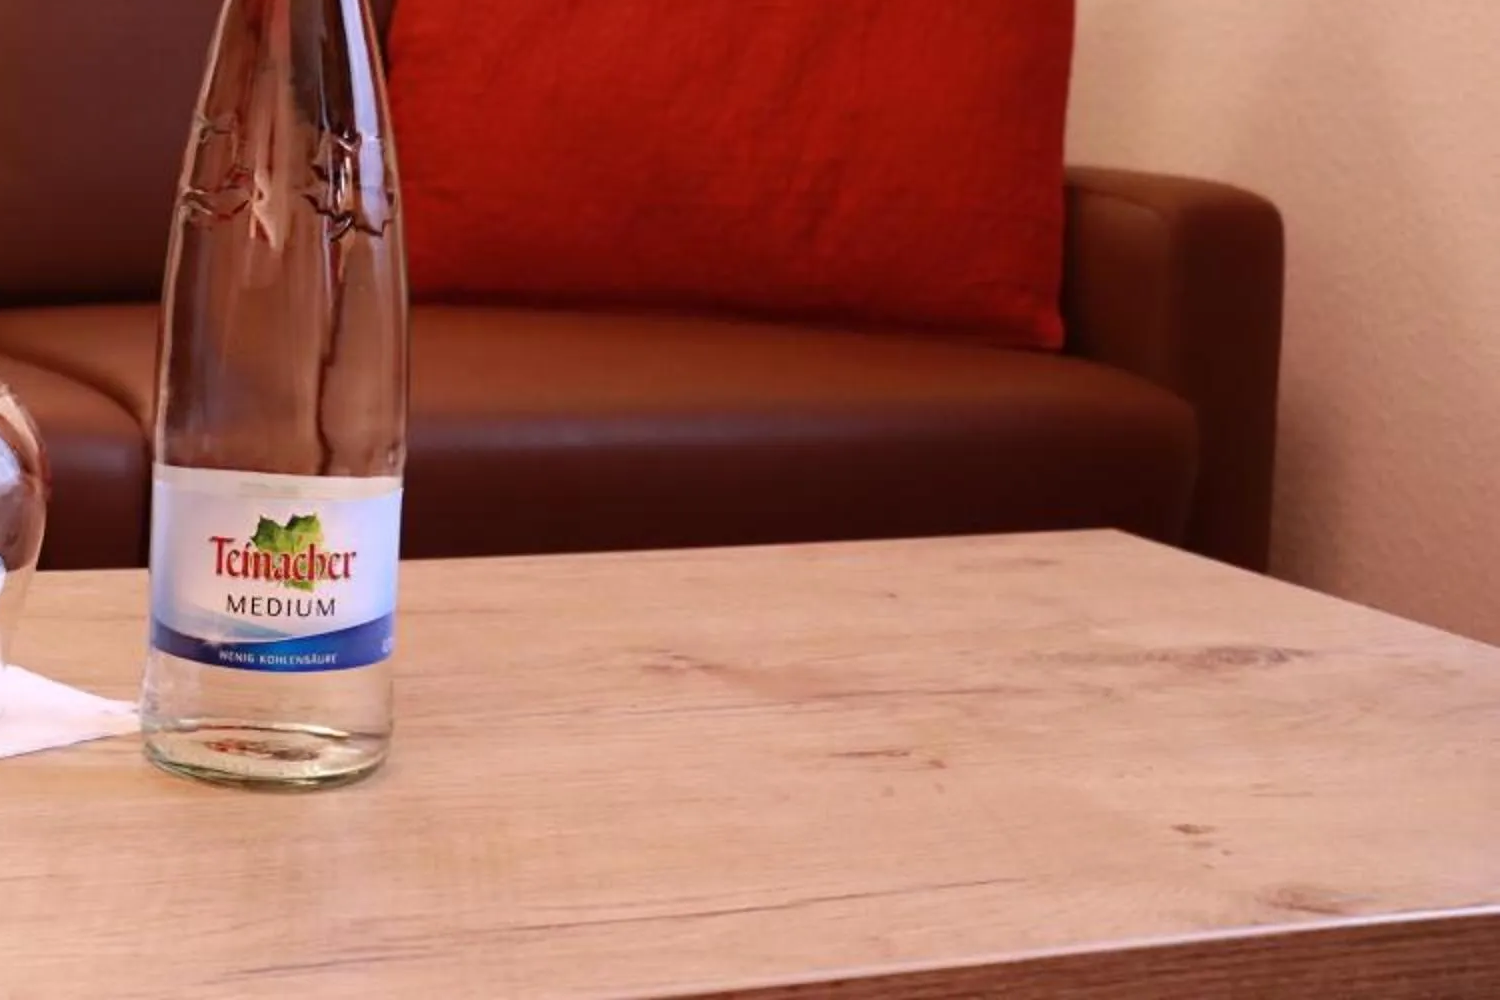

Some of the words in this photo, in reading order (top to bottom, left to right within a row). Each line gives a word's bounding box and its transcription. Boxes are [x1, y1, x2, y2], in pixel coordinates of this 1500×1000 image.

[209, 536, 357, 581] Teinacher
[226, 594, 335, 617] MEDIUM
[219, 650, 255, 664] WENIG
